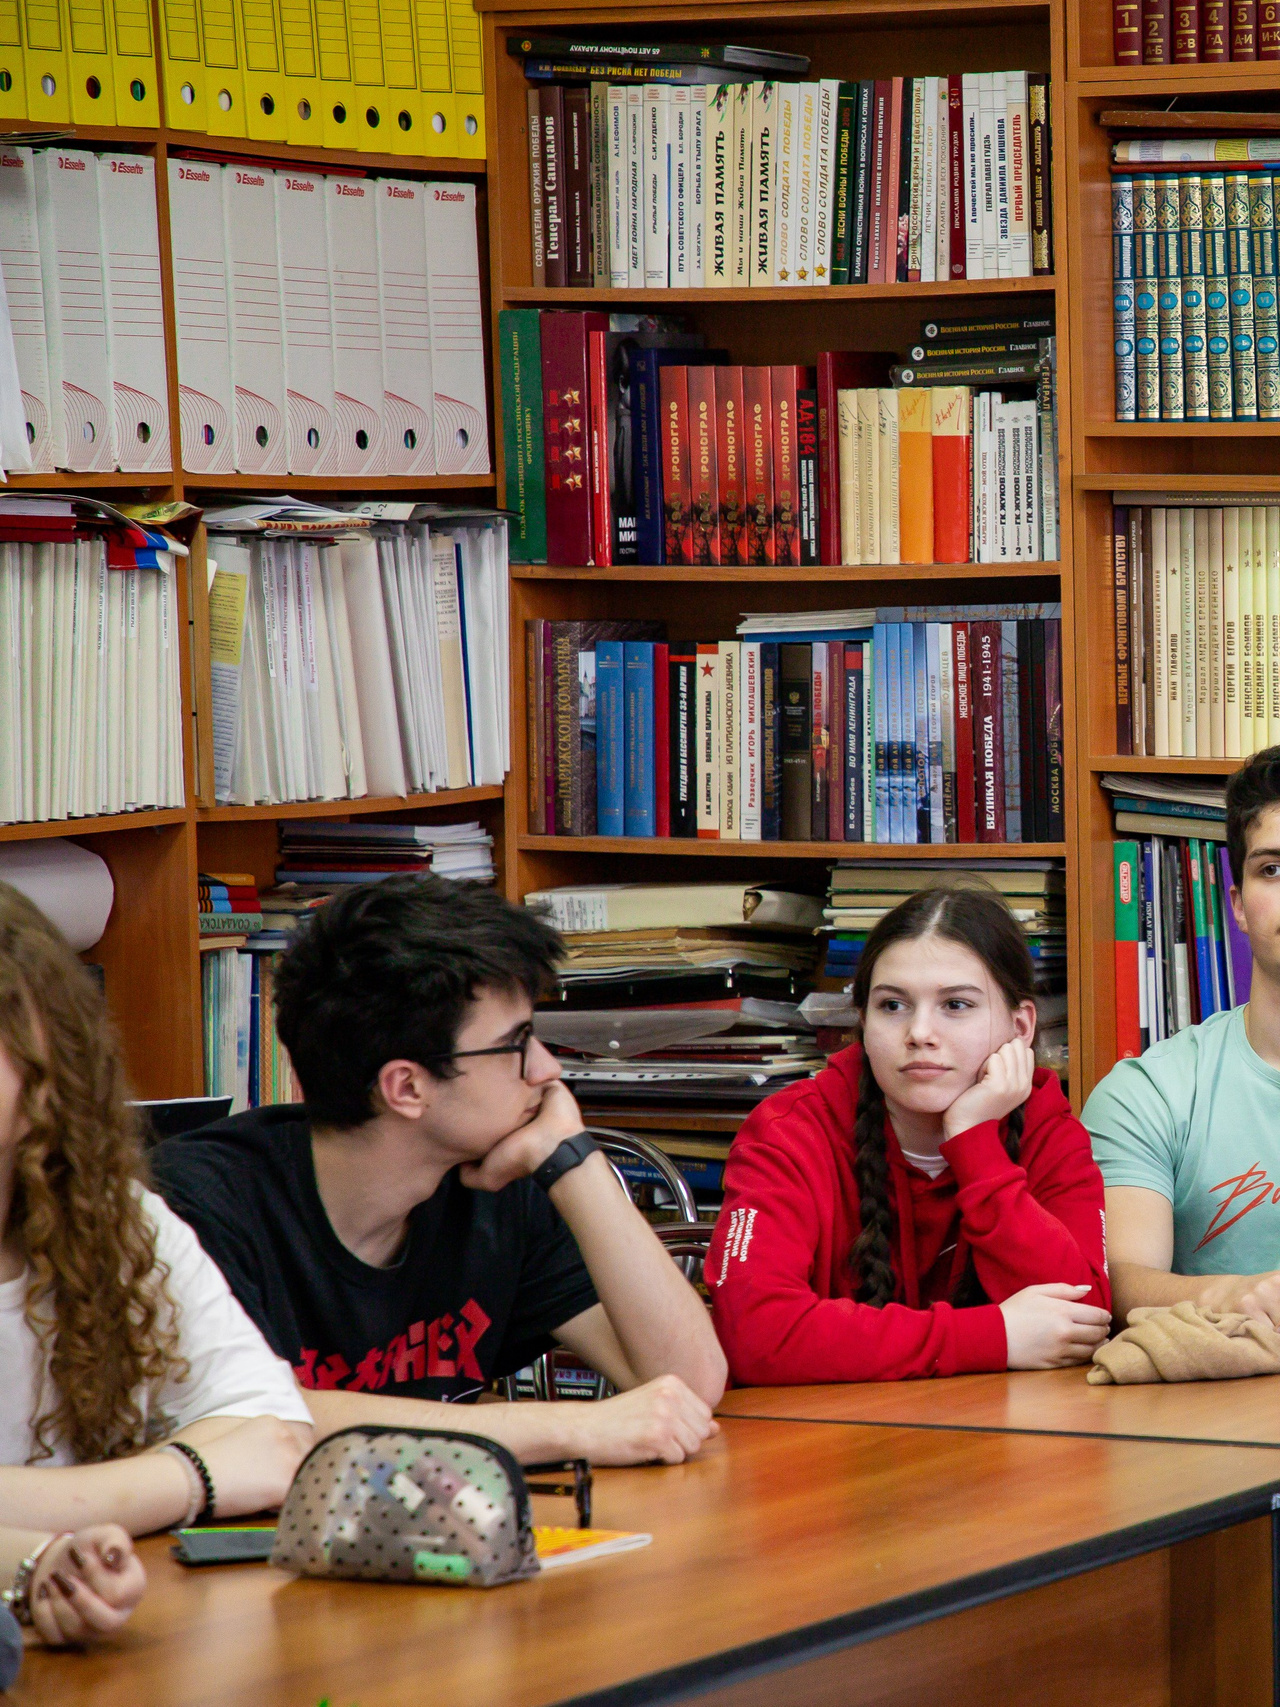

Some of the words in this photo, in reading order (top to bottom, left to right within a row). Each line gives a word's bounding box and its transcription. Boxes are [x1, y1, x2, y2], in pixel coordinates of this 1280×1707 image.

[1121, 12, 1129, 25] 1
[1180, 12, 1190, 27] 3
[1208, 9, 1218, 23] 4
[1237, 8, 1248, 22] 5
[1265, 6, 1275, 20] 6
[650, 69, 682, 78] ПОБЕДЫ
[531, 115, 540, 158] ПОБЕДЫ
[803, 95, 813, 151] ПОБЕДЫ
[820, 87, 830, 145] ПОБЕДЫ
[544, 115, 558, 191] Сандалов
[738, 127, 746, 171] Память
[840, 129, 849, 166] ПОБЕДЫ
[997, 118, 1006, 161] ШИШКОВА
[1012, 114, 1023, 181] ПРЕДСЕДАТЕЛЬ
[533, 162, 541, 204] ОРУЖИЯ
[715, 131, 725, 206] ПАМЯТЬ
[758, 127, 770, 204] ПАМЯТЬ
[800, 154, 811, 214] СОЛДАТА
[818, 148, 828, 208] СОЛДАТА
[857, 169, 865, 193] ВОЙНА
[970, 165, 977, 178] мы
[984, 158, 992, 181] ПАВЕЛ
[998, 165, 1008, 204] ДАНИИЛА
[837, 177, 847, 208] ВОЙНЫ
[984, 182, 992, 213] ГЕНЕРАЛ
[1013, 184, 1023, 222] ПЕРВЫЙ
[534, 209, 543, 268] СОЗДАТЕЛИ
[546, 195, 561, 260] Генерал
[757, 208, 769, 275] ЖИВАЯ
[799, 216, 808, 261] СЛОВО
[817, 211, 826, 256] СЛОВО
[837, 210, 846, 239] ПЕСНИ
[856, 194, 864, 246] ОТЕЧЕСТВЕННАЯ
[1000, 207, 1008, 240] ЗВЕЗДА
[714, 211, 724, 277] ЖИВАЯ
[670, 402, 681, 481] ХРОНОГРАФ
[726, 400, 736, 481] ХРОНОГРАФ
[780, 400, 791, 481] ХРОНОГРАФ
[1013, 477, 1021, 511] ЖУКОВ
[1115, 534, 1126, 586] БРАТСТВУ
[957, 630, 966, 660] ПОБЕДЫ
[1116, 589, 1128, 661] ФРОНТОВОМУ
[1226, 621, 1235, 656] ЕГОРОВ
[746, 651, 755, 723] МИКЛАШЕВСКИЙ
[958, 662, 967, 681] ЛИЦО
[981, 635, 992, 697] 1941-1945
[1118, 664, 1128, 705] ВЕРНЫЕ
[1226, 664, 1235, 703] ГЕОРГИЙ
[848, 676, 856, 732] ЛЕНИНГРАДА
[959, 683, 968, 718] ЖЕНСКОЕ
[726, 756, 733, 765] ИЗ
[848, 734, 856, 753] ИМЯ
[849, 755, 856, 767] ВО
[983, 715, 994, 768] ПОБЕДА
[985, 770, 996, 829] ВЕЛИКАЯ
